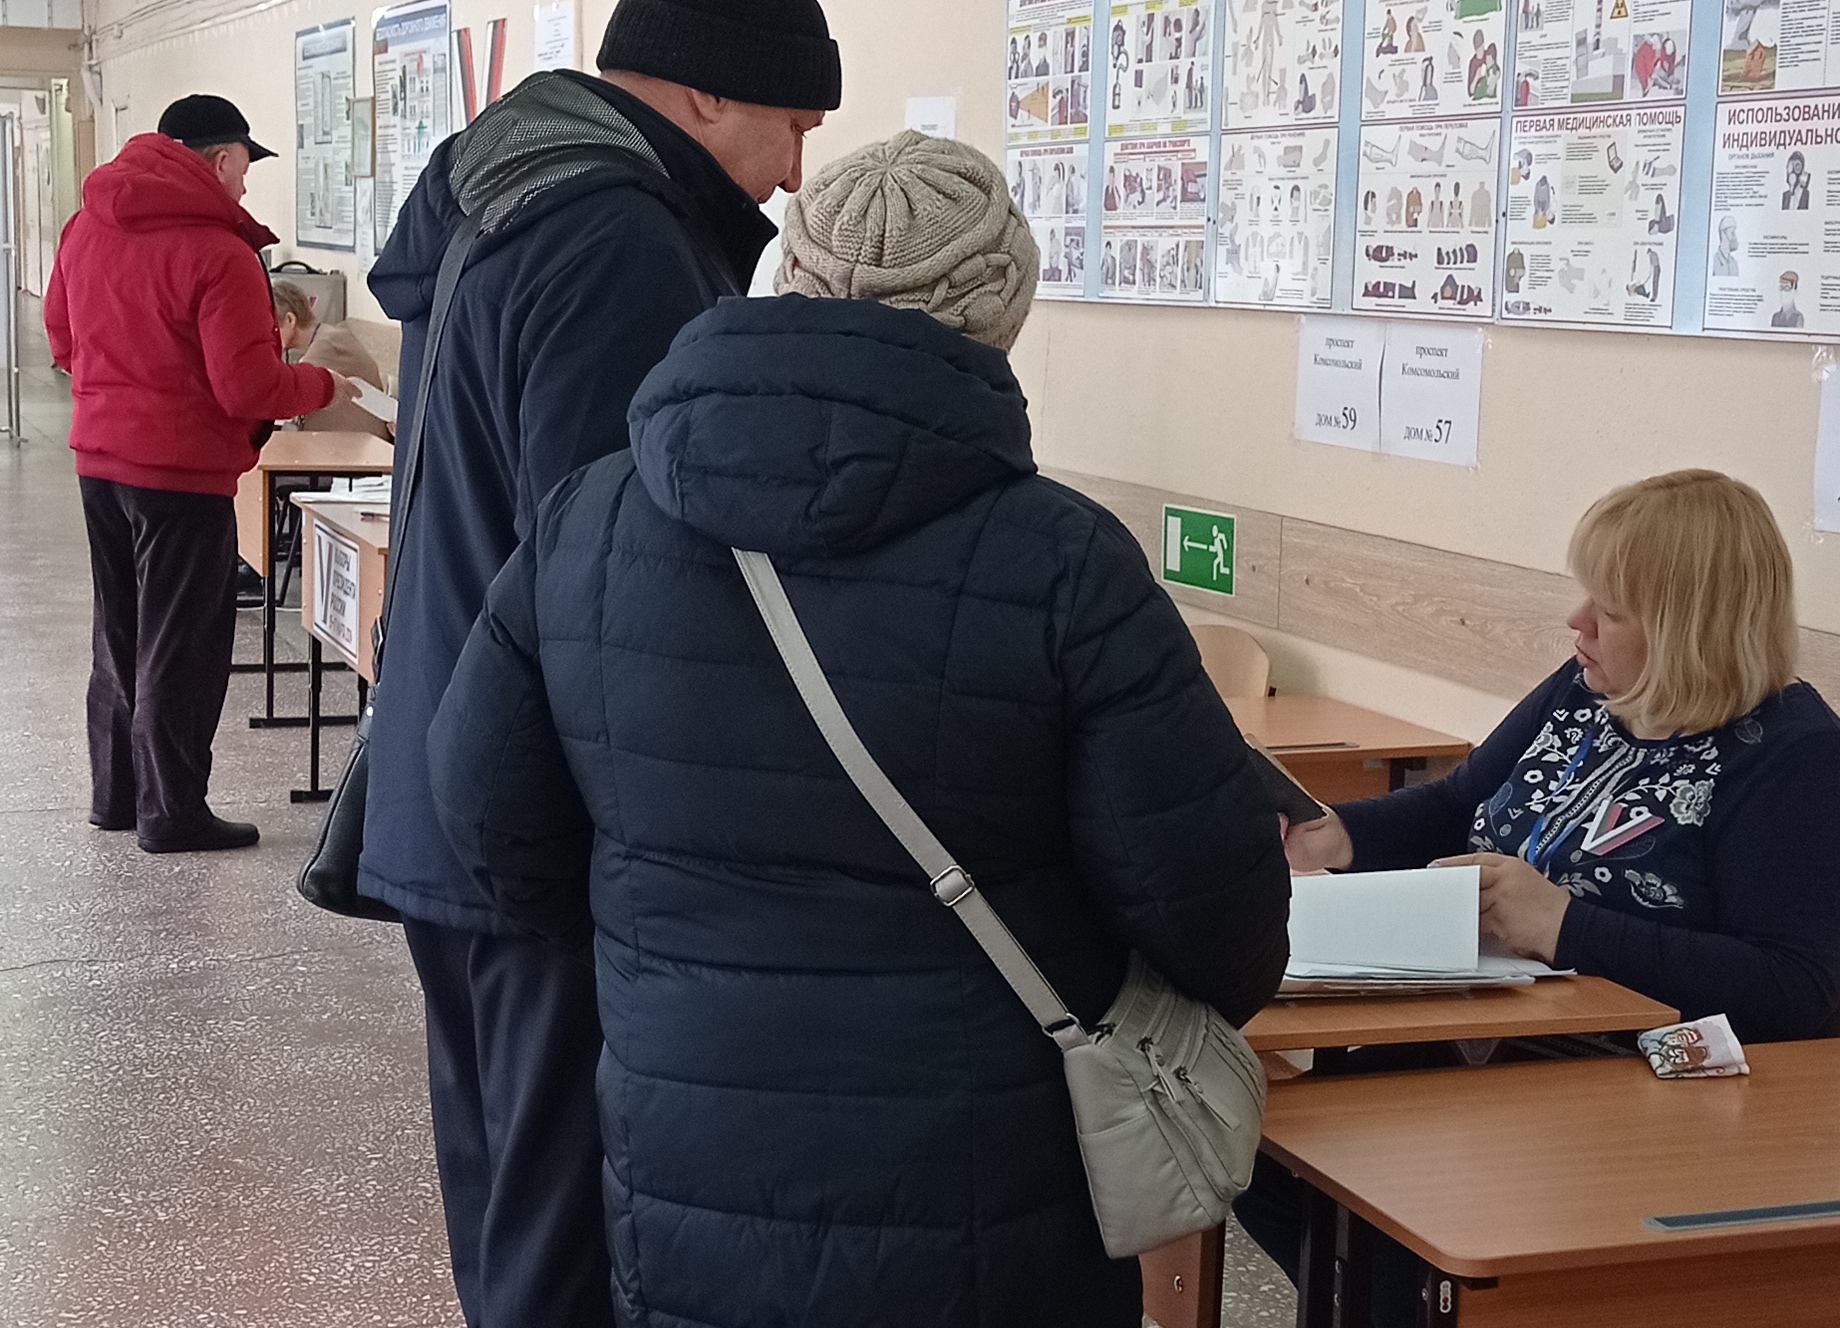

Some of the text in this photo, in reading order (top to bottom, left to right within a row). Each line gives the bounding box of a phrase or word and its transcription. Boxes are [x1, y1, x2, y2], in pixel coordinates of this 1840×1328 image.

[1516, 110, 1682, 133] ПЕРВАЯ МЕДИЦИНСКАЯ ПОМОЩЬ
[1728, 102, 1840, 126] ИСПОЛЬЗОВАНИ
[1723, 127, 1840, 151] ИНДИВИДУАЛЬНО
[1325, 337, 1354, 350] проспект
[1415, 345, 1448, 358] проспект
[1313, 353, 1362, 371] Комсомольский
[1401, 363, 1460, 380] Комсомольский
